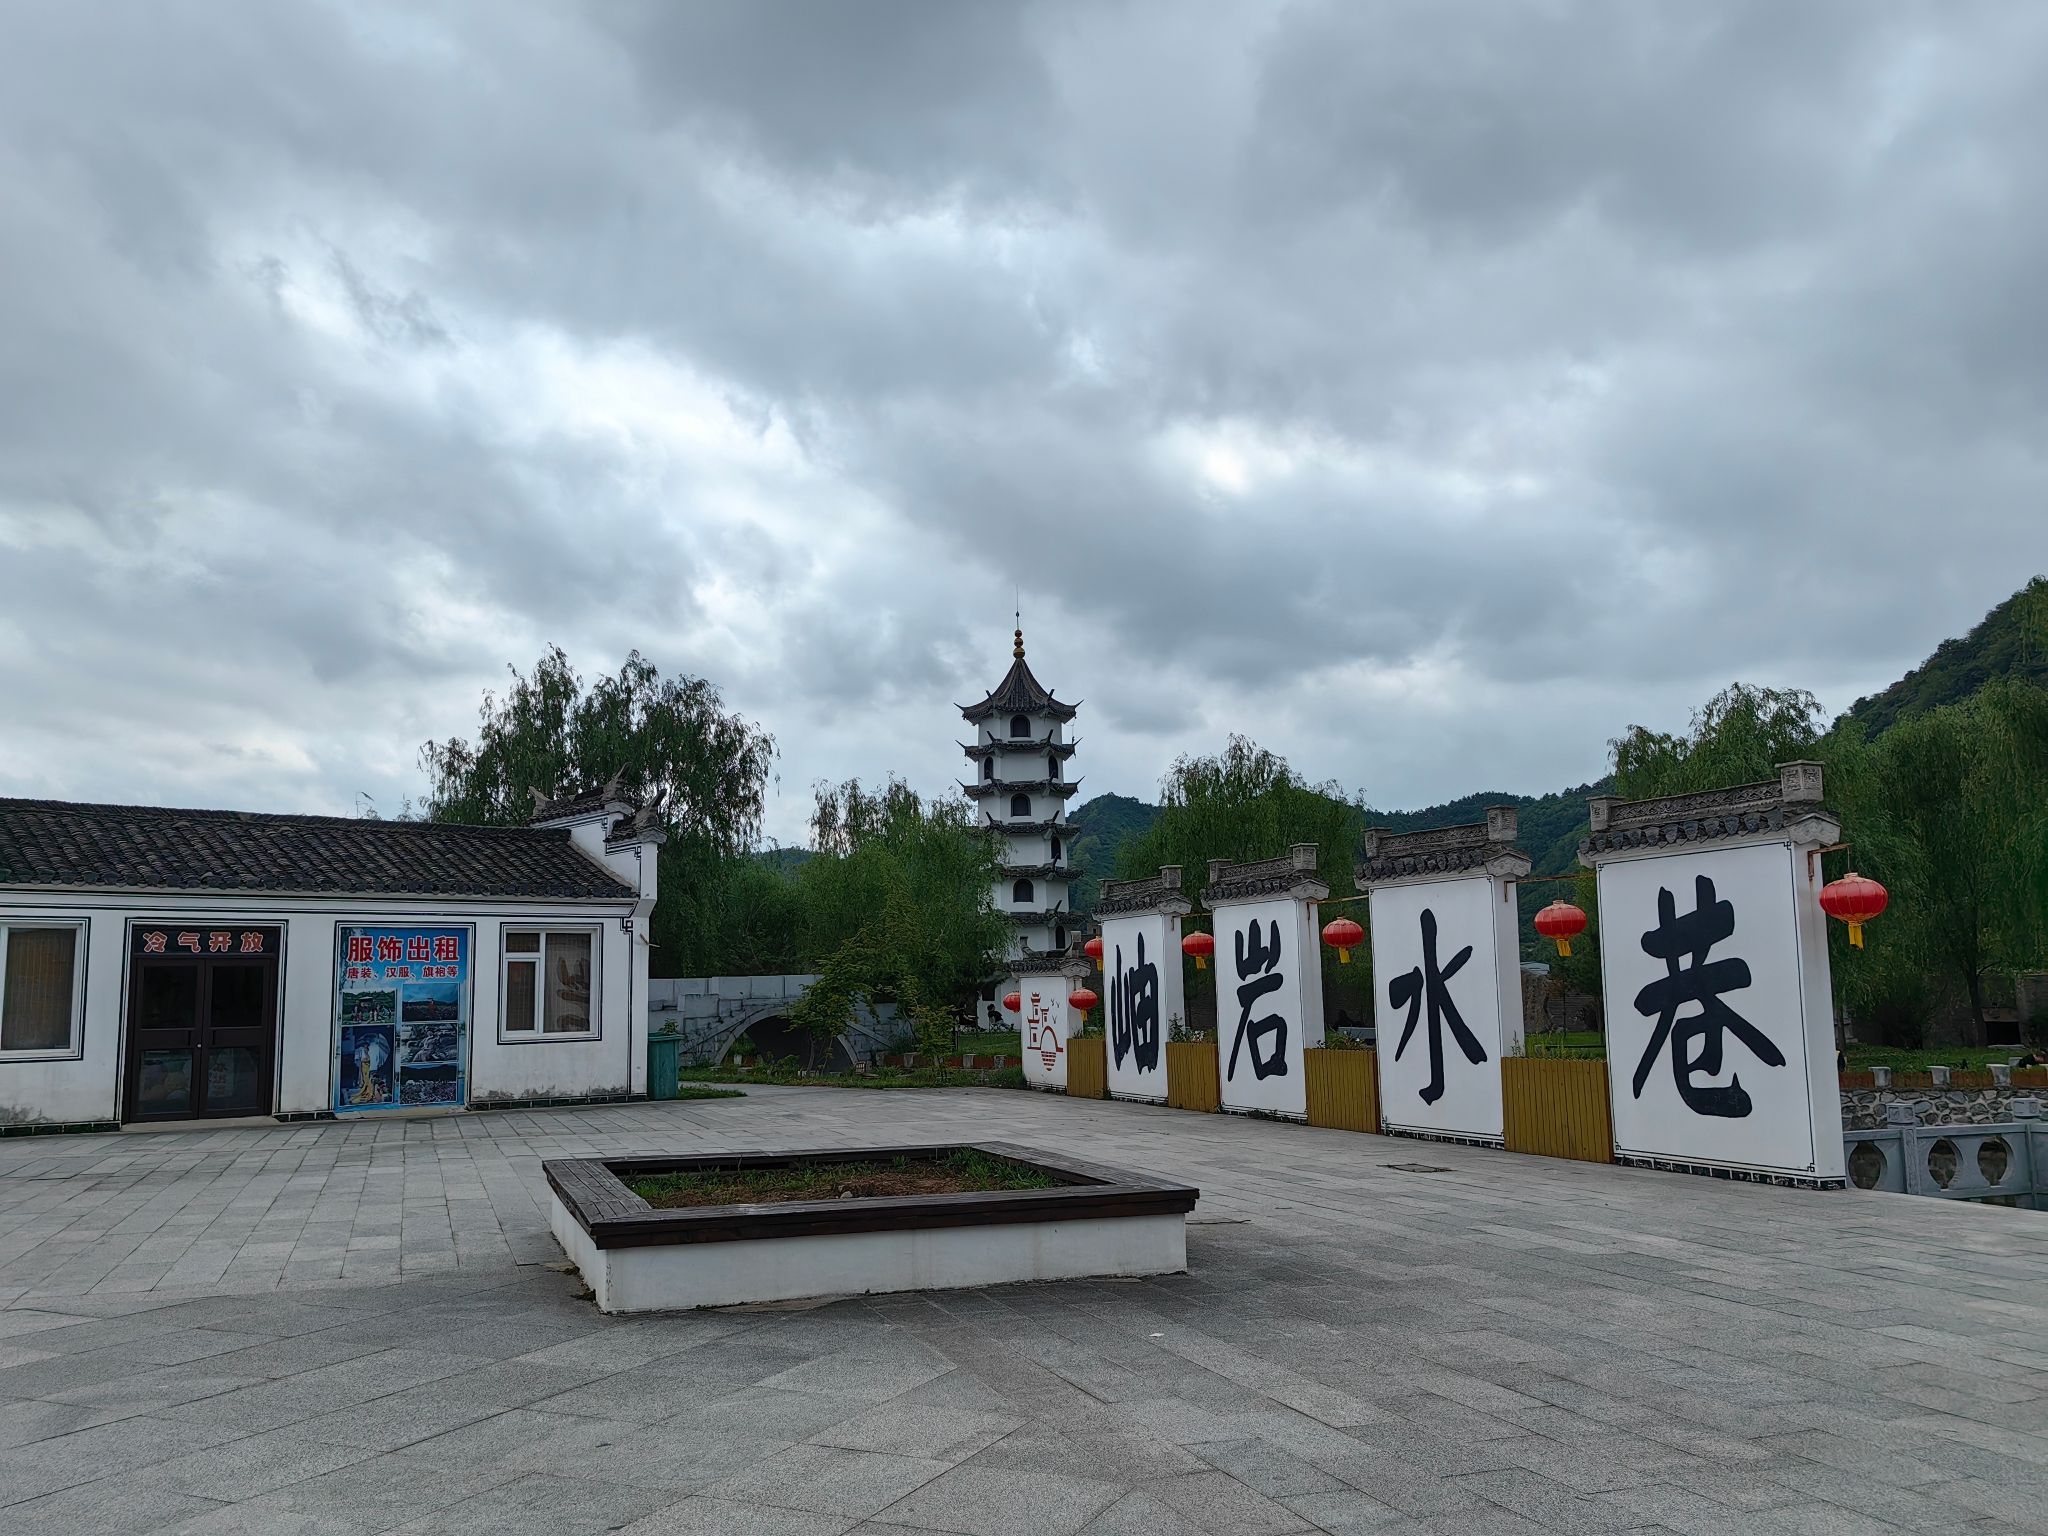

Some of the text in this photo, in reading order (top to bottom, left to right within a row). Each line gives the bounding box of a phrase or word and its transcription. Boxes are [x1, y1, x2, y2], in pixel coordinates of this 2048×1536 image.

[143, 931, 263, 953] 冷气开放
[347, 935, 459, 962] 服饰出租
[347, 966, 459, 979] 唐装、汉服、旗袍等
